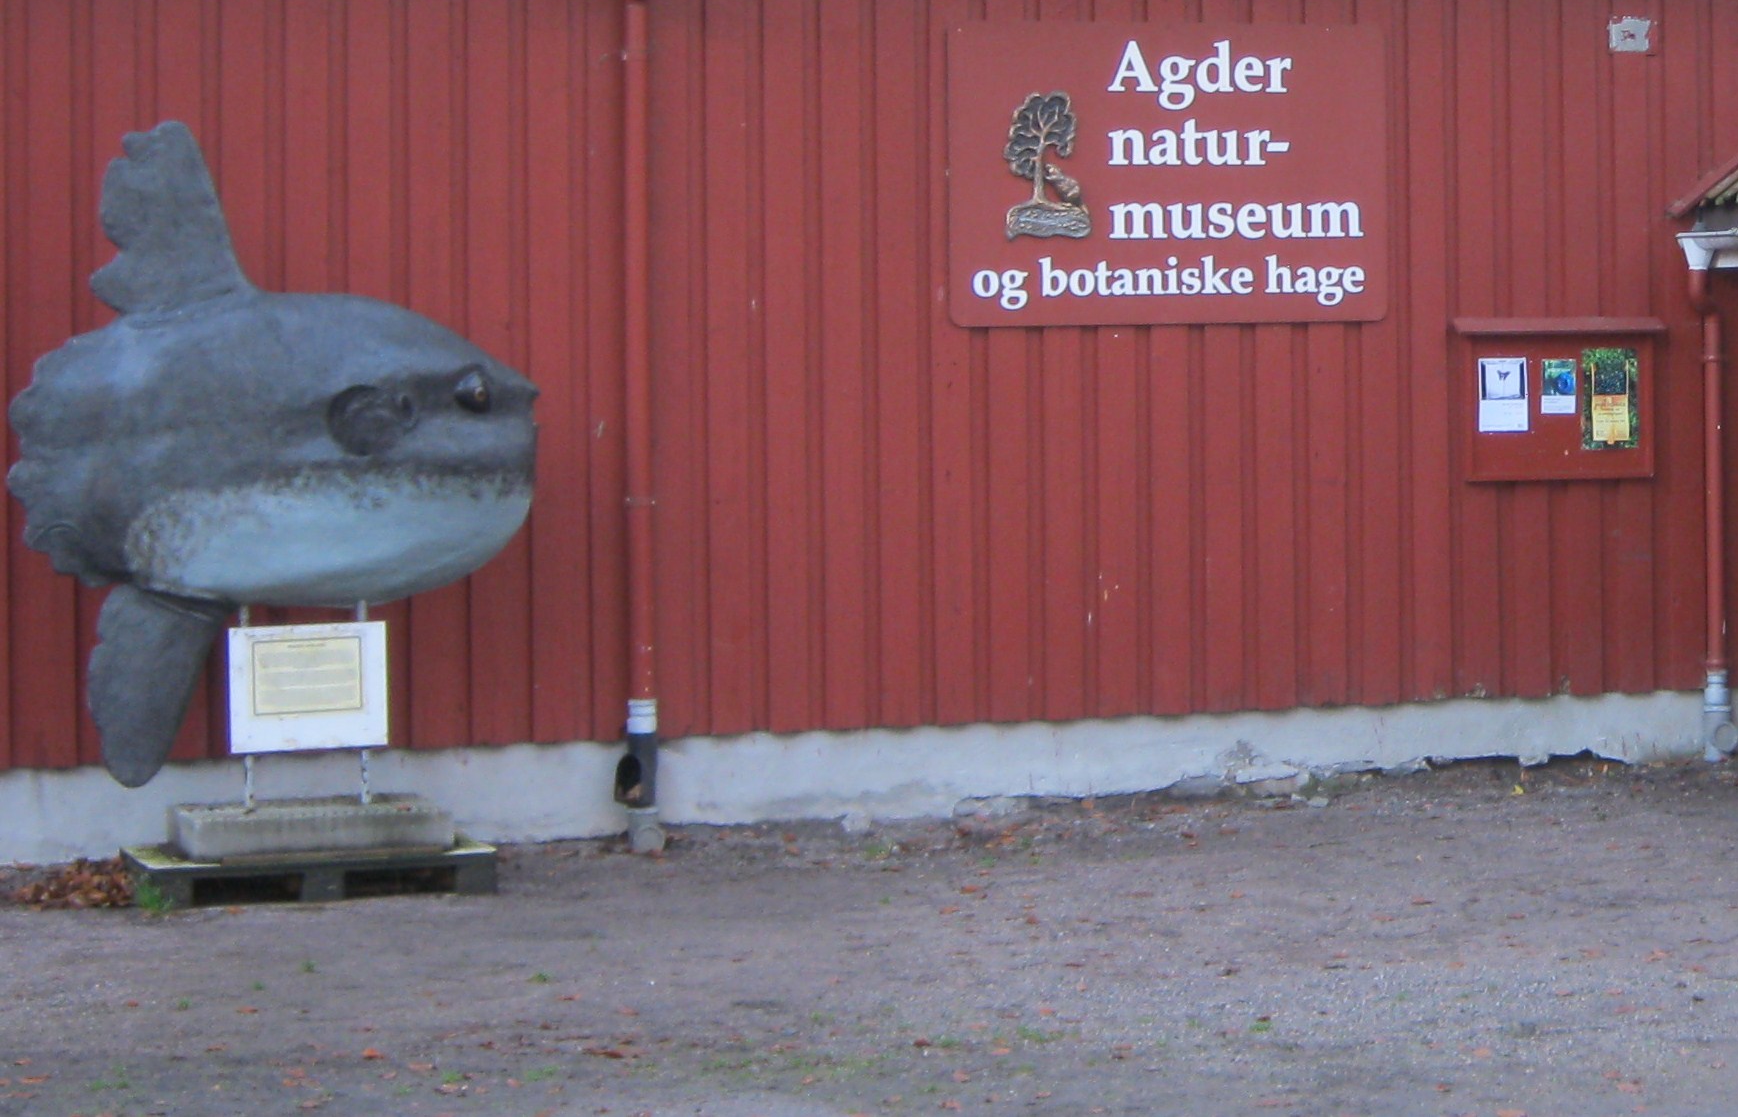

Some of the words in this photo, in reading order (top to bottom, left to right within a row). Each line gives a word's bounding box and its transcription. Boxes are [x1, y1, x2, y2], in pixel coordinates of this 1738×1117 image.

[1107, 39, 1292, 110] Agder
[1107, 118, 1290, 166] natur-
[1108, 201, 1364, 239] museum
[973, 269, 1029, 310] og
[1038, 255, 1254, 297] botaniske
[1264, 254, 1365, 306] hage
